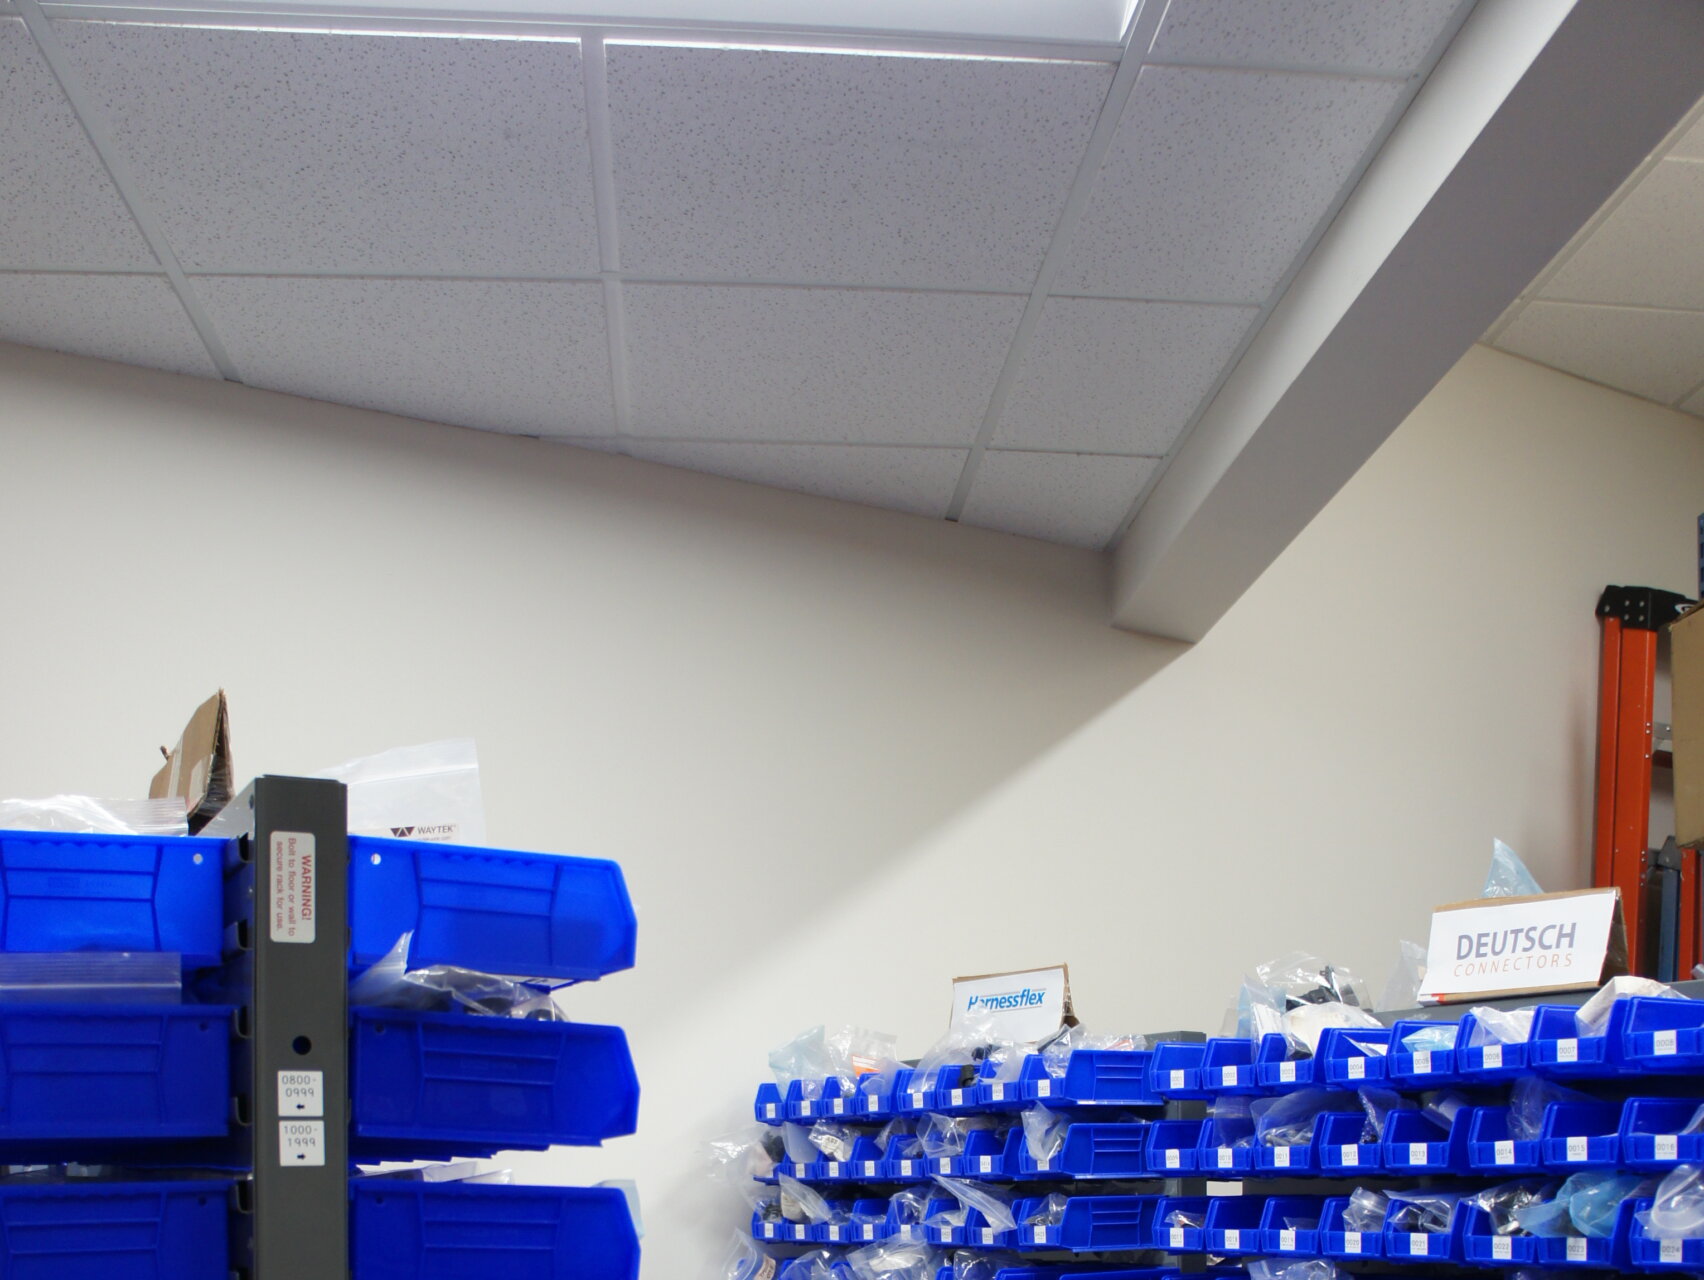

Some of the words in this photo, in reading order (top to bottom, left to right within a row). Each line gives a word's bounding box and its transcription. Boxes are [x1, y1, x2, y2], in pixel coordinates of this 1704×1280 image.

[288, 838, 296, 856] Bolt
[288, 859, 296, 867] to
[276, 874, 284, 893] rack
[288, 872, 296, 891] floor
[301, 855, 312, 920] WARNING!
[288, 895, 294, 903] or
[276, 898, 284, 910] for
[288, 907, 296, 924] wall
[288, 927, 295, 936] to
[1456, 922, 1577, 961] DEUTSCH
[1453, 953, 1573, 977] CONNECTORS
[1559, 1046, 1576, 1054] 0007
[282, 1075, 317, 1085] 0800-
[285, 1088, 315, 1097] 0999
[284, 1125, 318, 1135] 1000-
[288, 1138, 316, 1147] 1999
[1657, 1143, 1675, 1151] 0016
[1497, 1148, 1513, 1156] 0014
[1569, 1144, 1585, 1152] 0015
[1275, 1152, 1289, 1160] 0011
[1346, 1238, 1360, 1246] 0020
[1495, 1243, 1510, 1251] 0022
